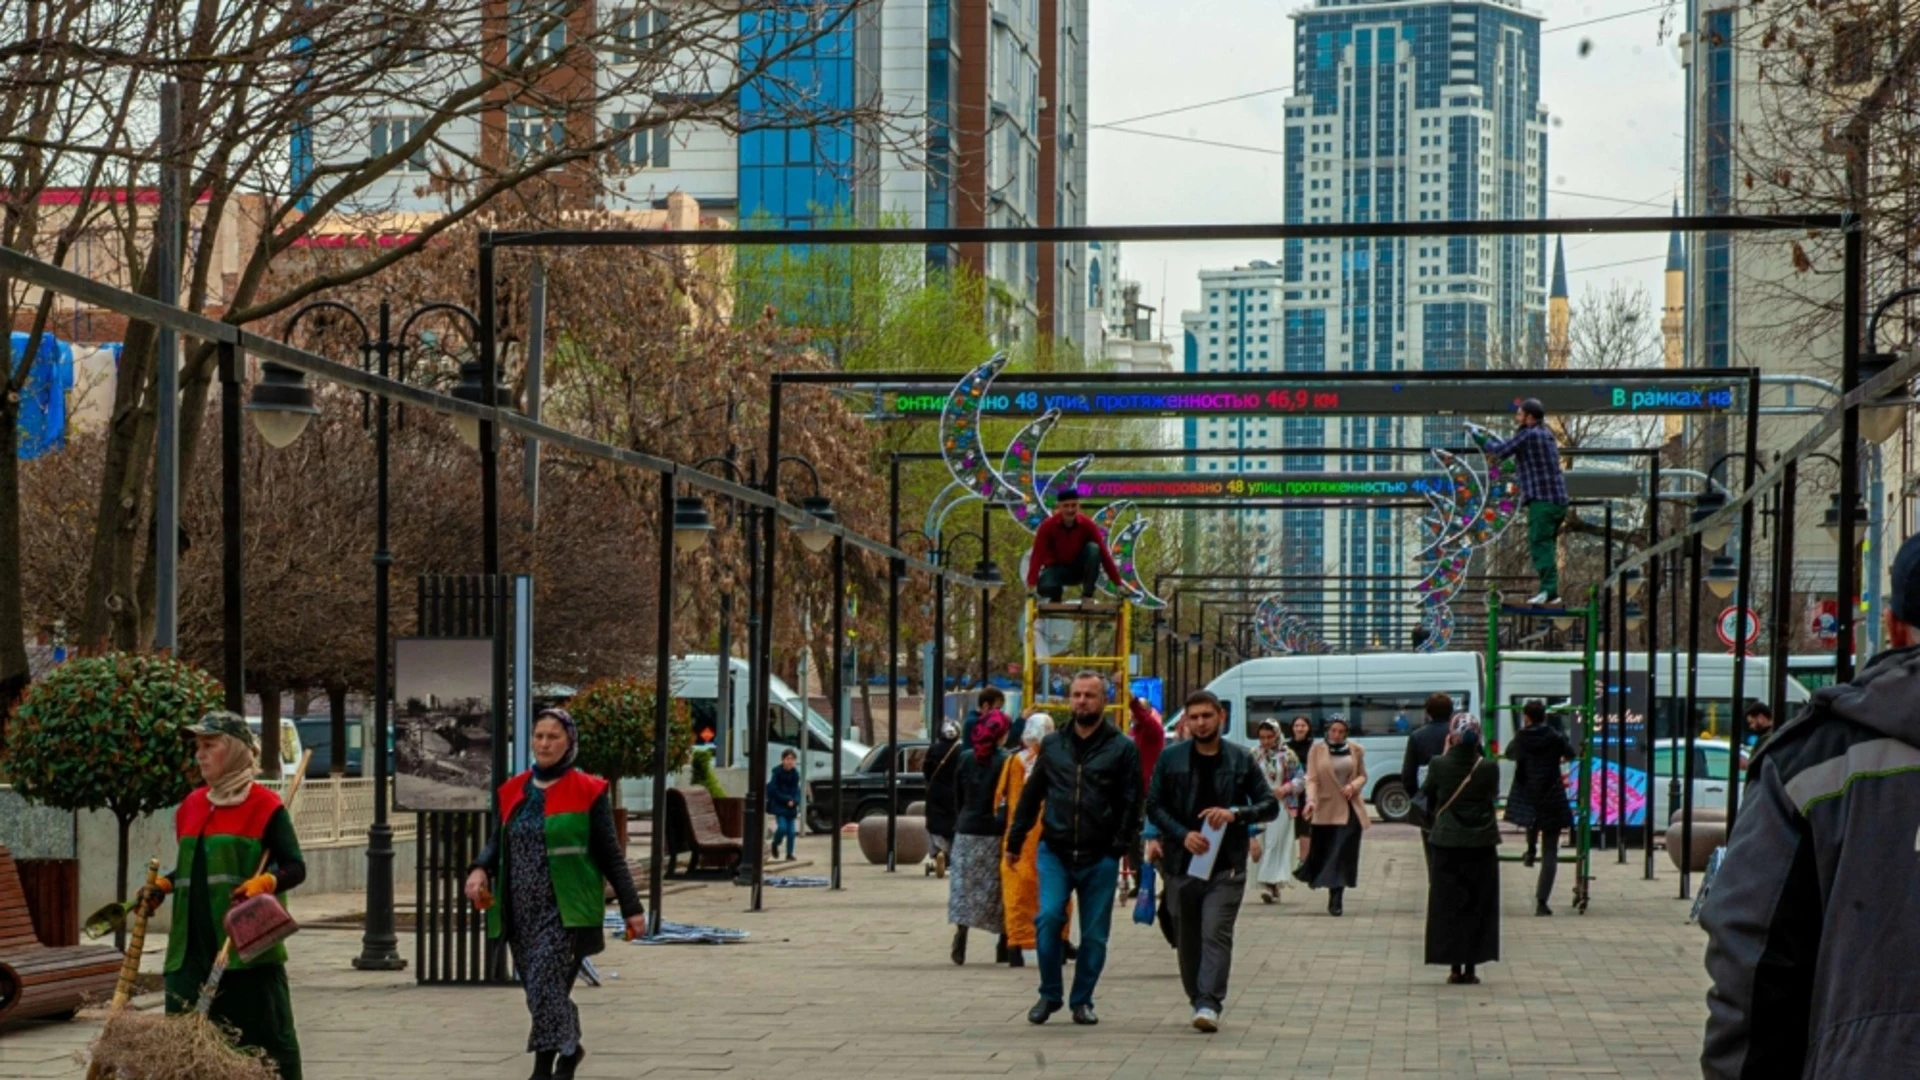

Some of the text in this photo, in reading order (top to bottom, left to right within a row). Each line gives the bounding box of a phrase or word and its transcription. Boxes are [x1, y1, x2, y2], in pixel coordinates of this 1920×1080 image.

[1014, 392, 1038, 411] 48
[1044, 396, 1090, 412] улиц
[1095, 393, 1260, 412] протяженностью
[1265, 390, 1308, 412] 46,9
[1314, 394, 1338, 408] км
[1612, 387, 1731, 410] В рамках на
[1226, 479, 1245, 494] 48
[1248, 481, 1283, 496] улиц
[1286, 480, 1407, 495] протяженностью
